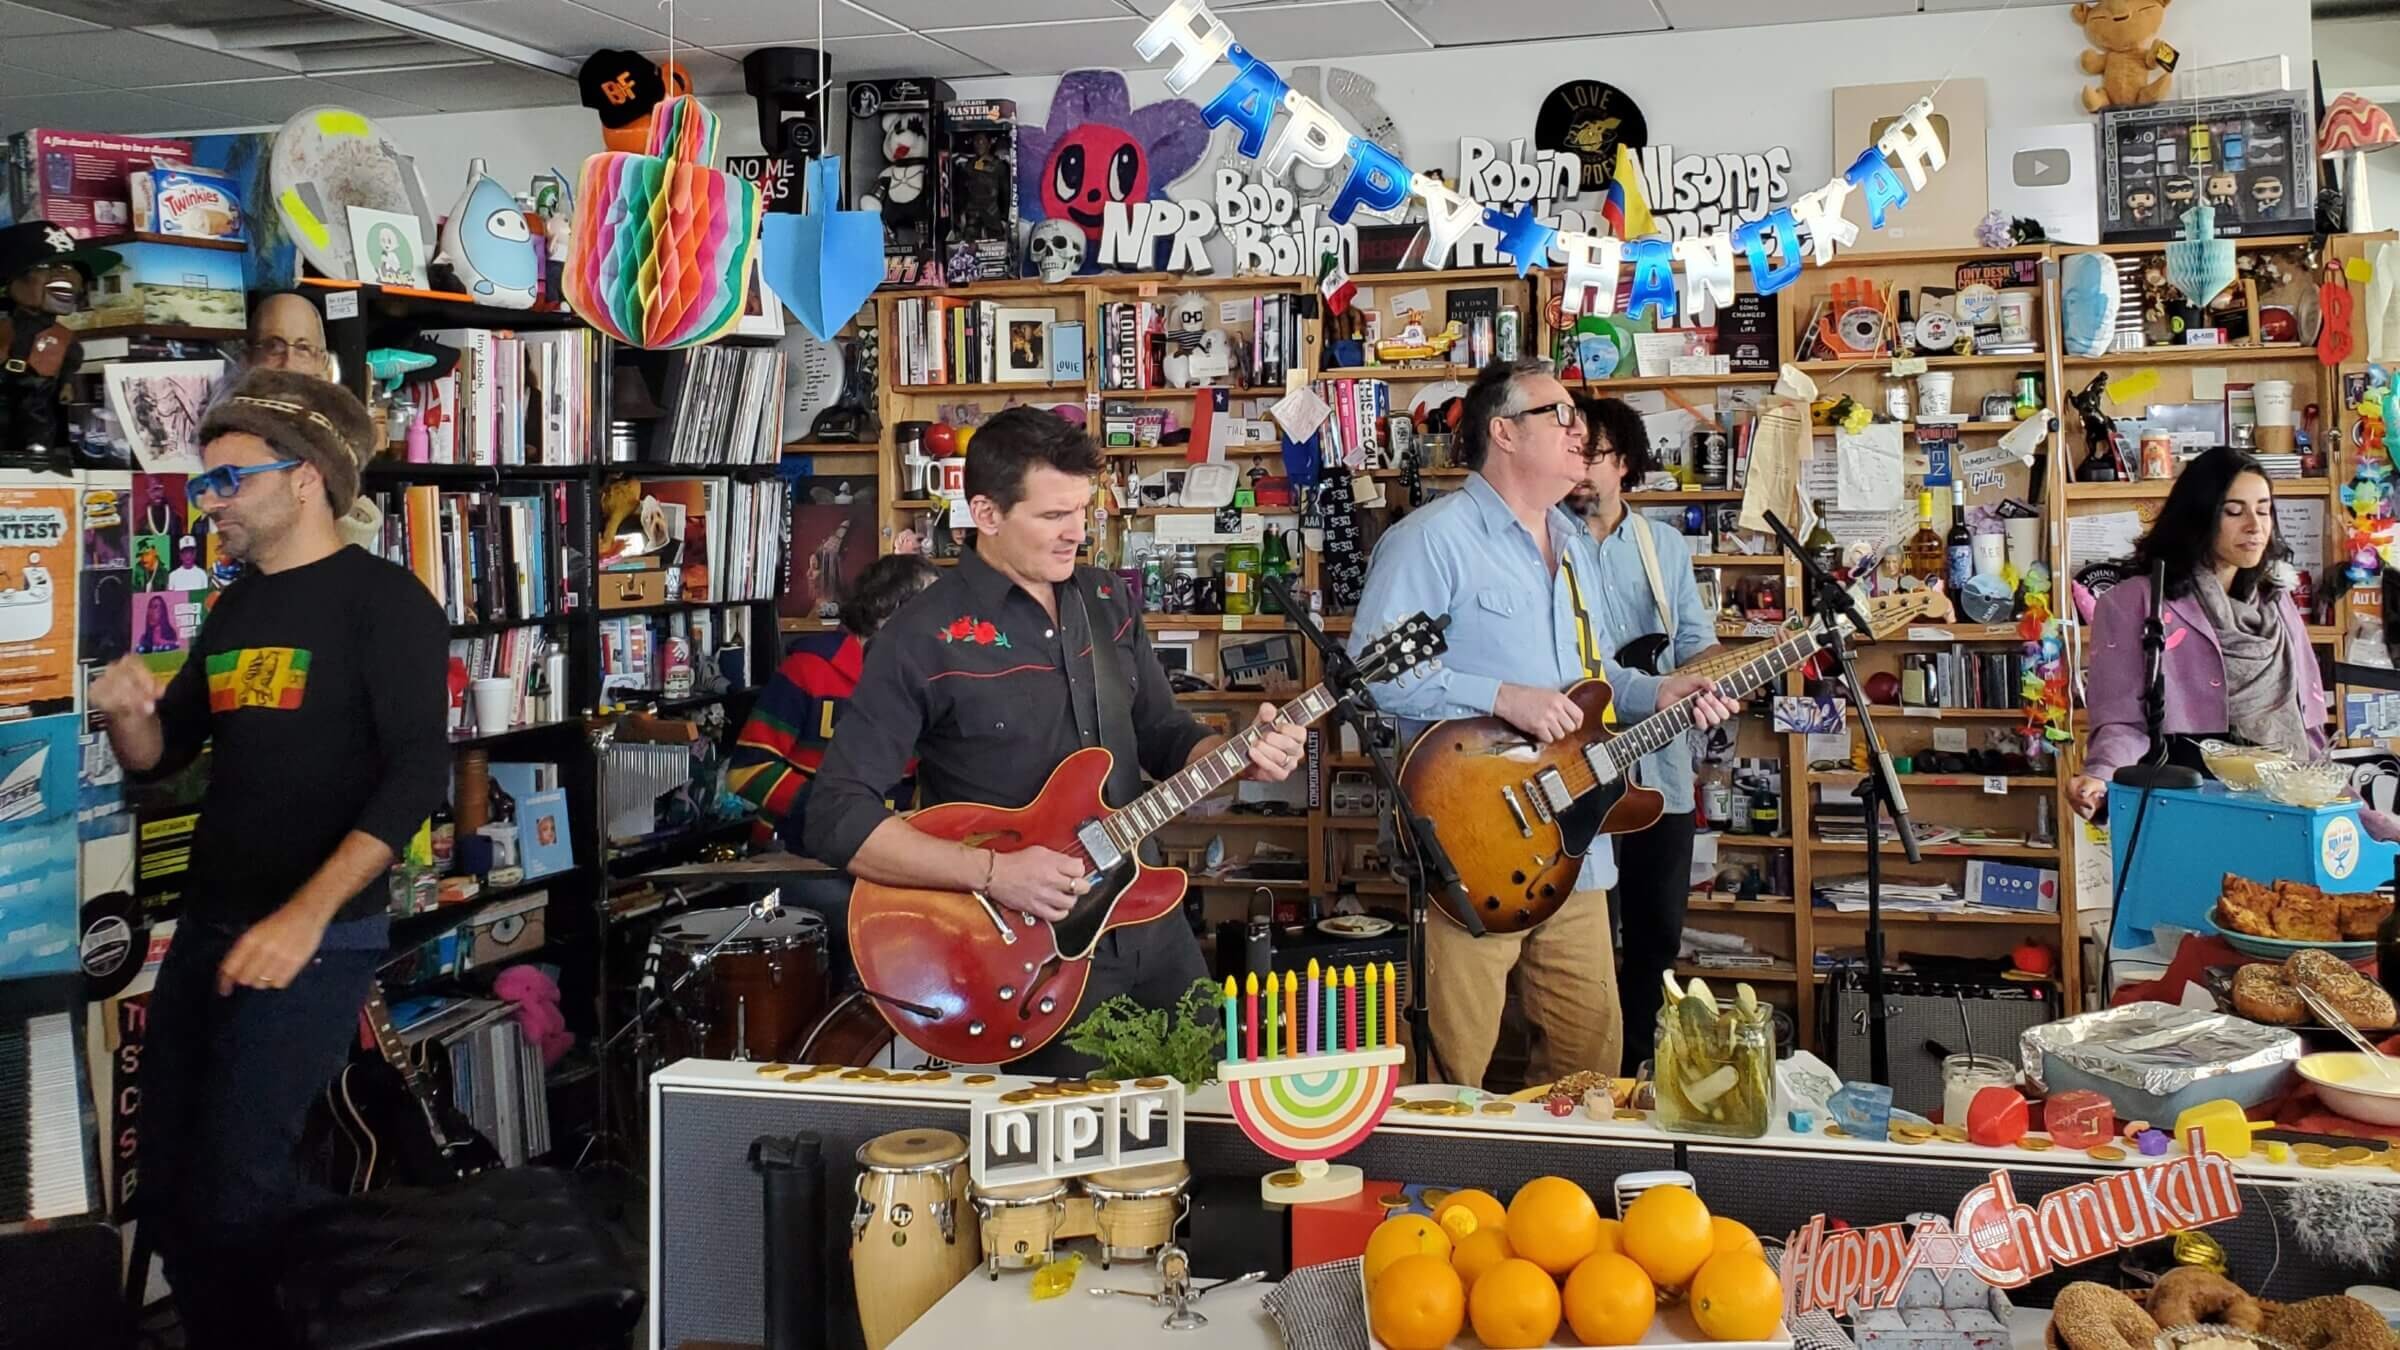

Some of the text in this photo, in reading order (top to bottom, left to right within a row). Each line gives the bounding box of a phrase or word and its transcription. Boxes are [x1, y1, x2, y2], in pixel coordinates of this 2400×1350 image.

[947, 105, 990, 116] MASTER
[1561, 85, 1612, 111] LOVE
[1133, 0, 1485, 270] HAPPY
[729, 158, 795, 180] NO ME
[1216, 168, 1294, 226] Bob
[1459, 136, 1581, 201] Robin
[165, 190, 220, 217] Twinkies
[1097, 200, 1217, 274] NPR
[477, 334, 485, 390] tiny book
[1309, 730, 1320, 808] COMMONWEALTH
[991, 1097, 1163, 1163] npr
[1956, 1128, 2238, 1288] Chanukah
[1797, 1216, 1917, 1316] Happy
